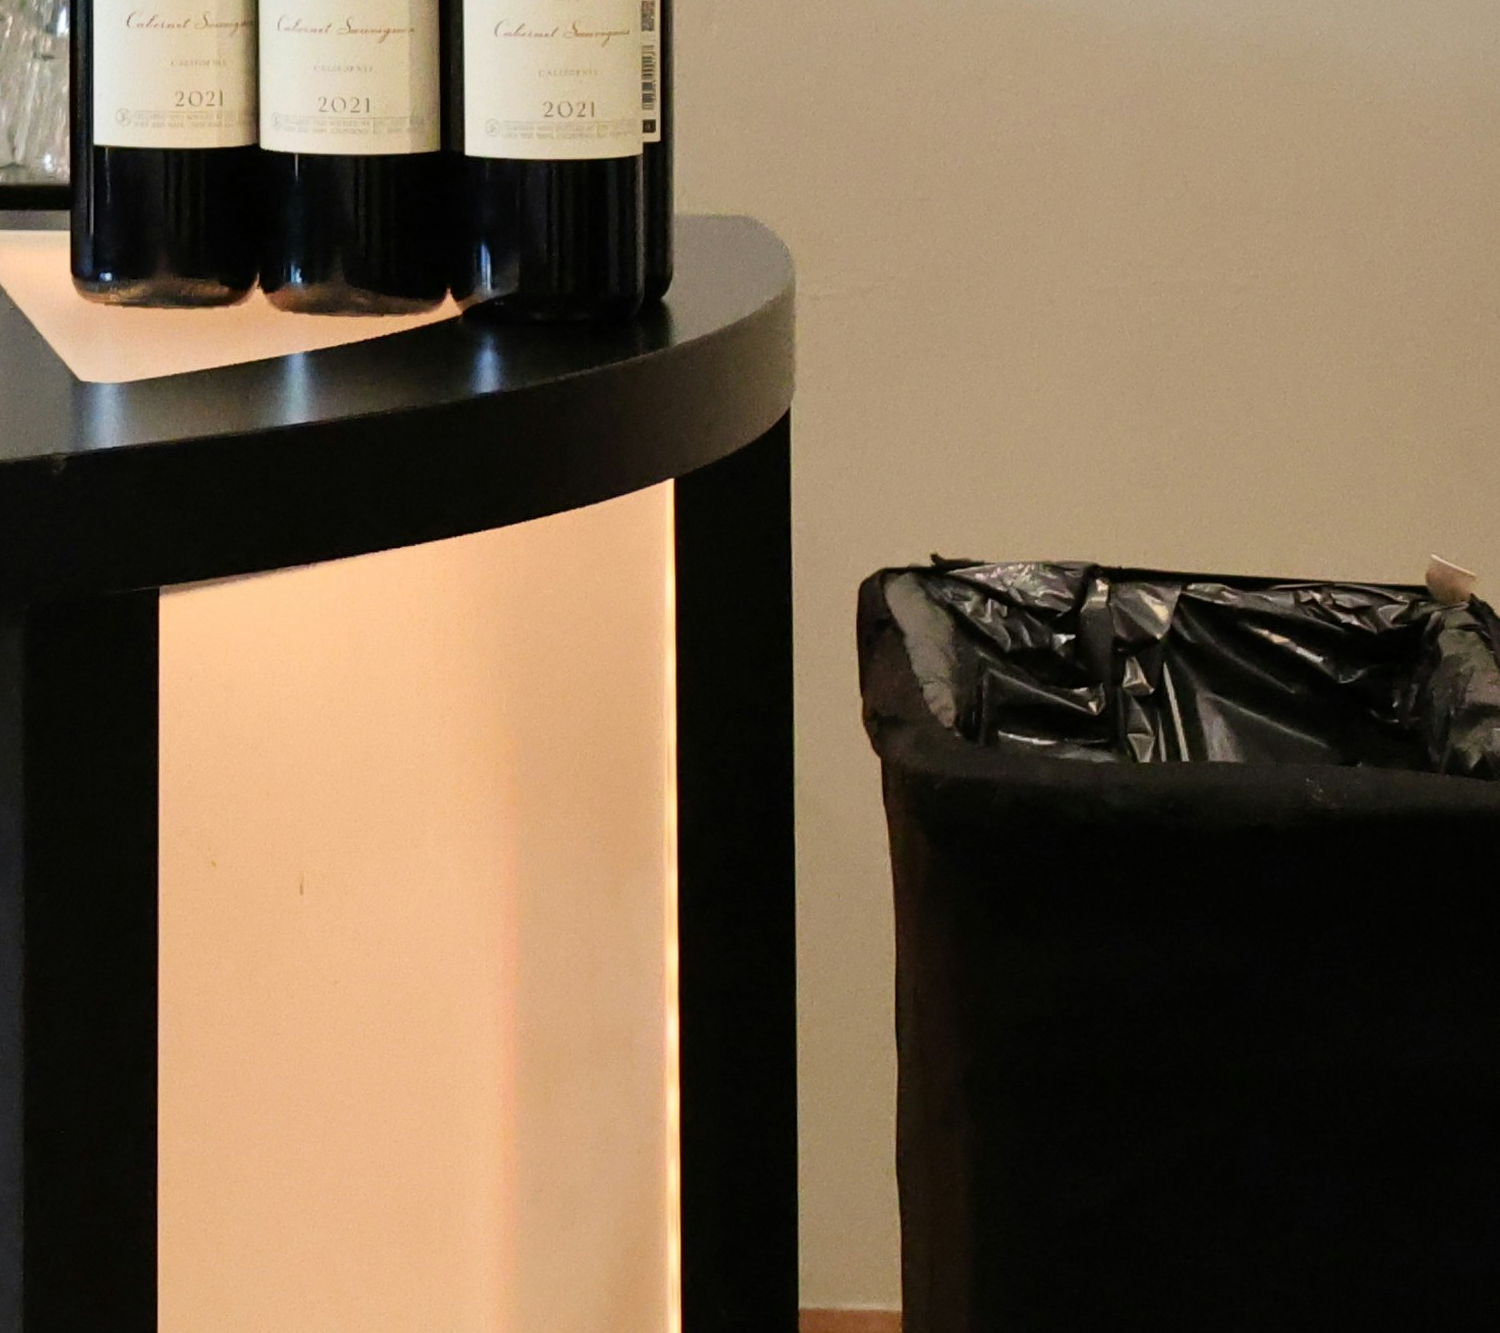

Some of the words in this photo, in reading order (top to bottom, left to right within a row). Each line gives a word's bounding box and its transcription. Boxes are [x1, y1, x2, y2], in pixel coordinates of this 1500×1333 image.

[175, 90, 224, 108] 2021
[318, 96, 371, 114] 2021
[542, 101, 596, 118] 2021
